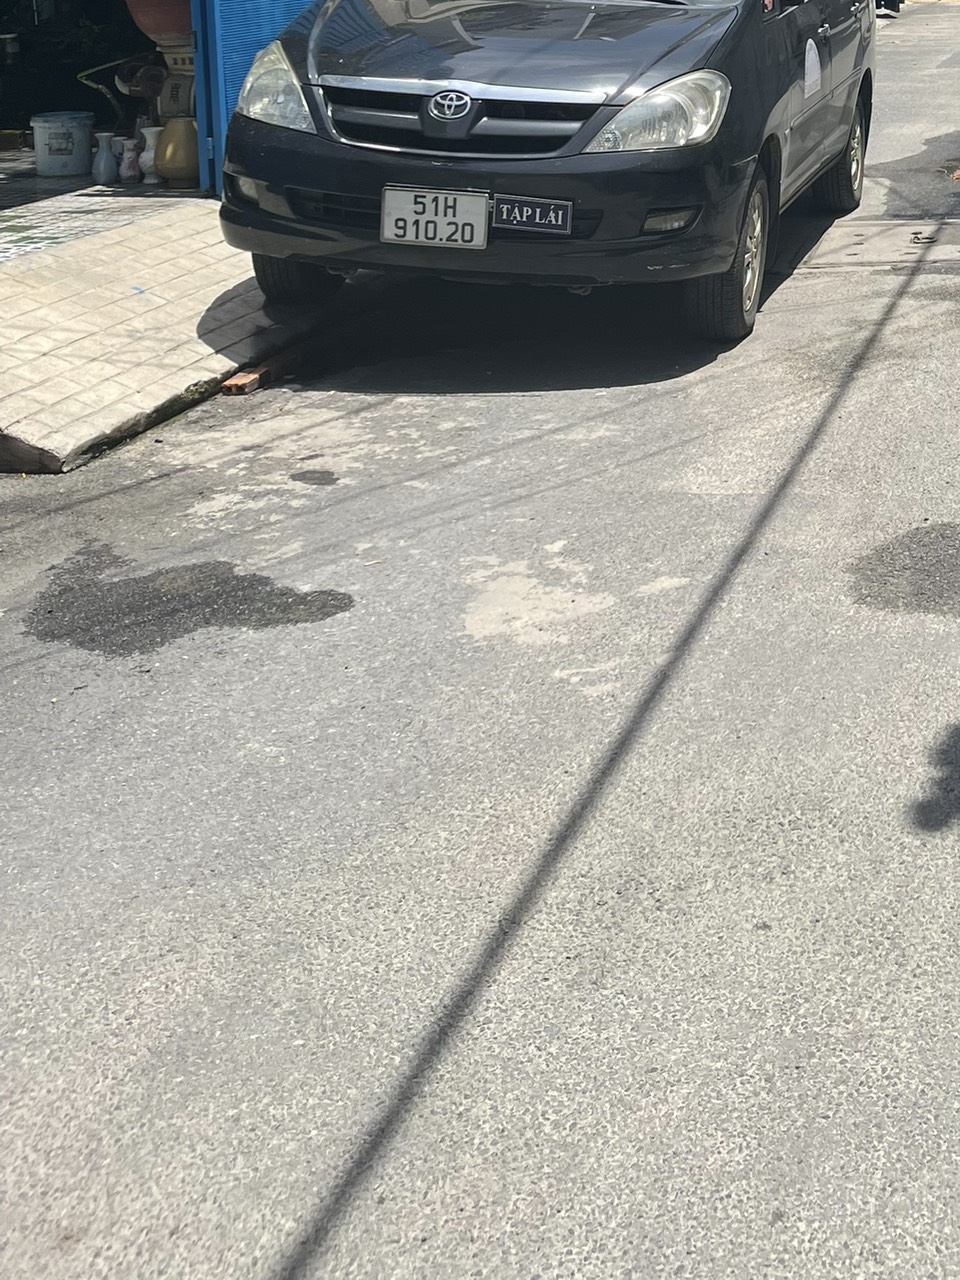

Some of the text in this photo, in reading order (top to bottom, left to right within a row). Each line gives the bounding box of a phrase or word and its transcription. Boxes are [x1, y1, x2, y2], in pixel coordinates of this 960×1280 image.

[413, 194, 458, 218] 51H
[500, 202, 564, 225] TẬP LÁI
[394, 217, 475, 244] 910.20
